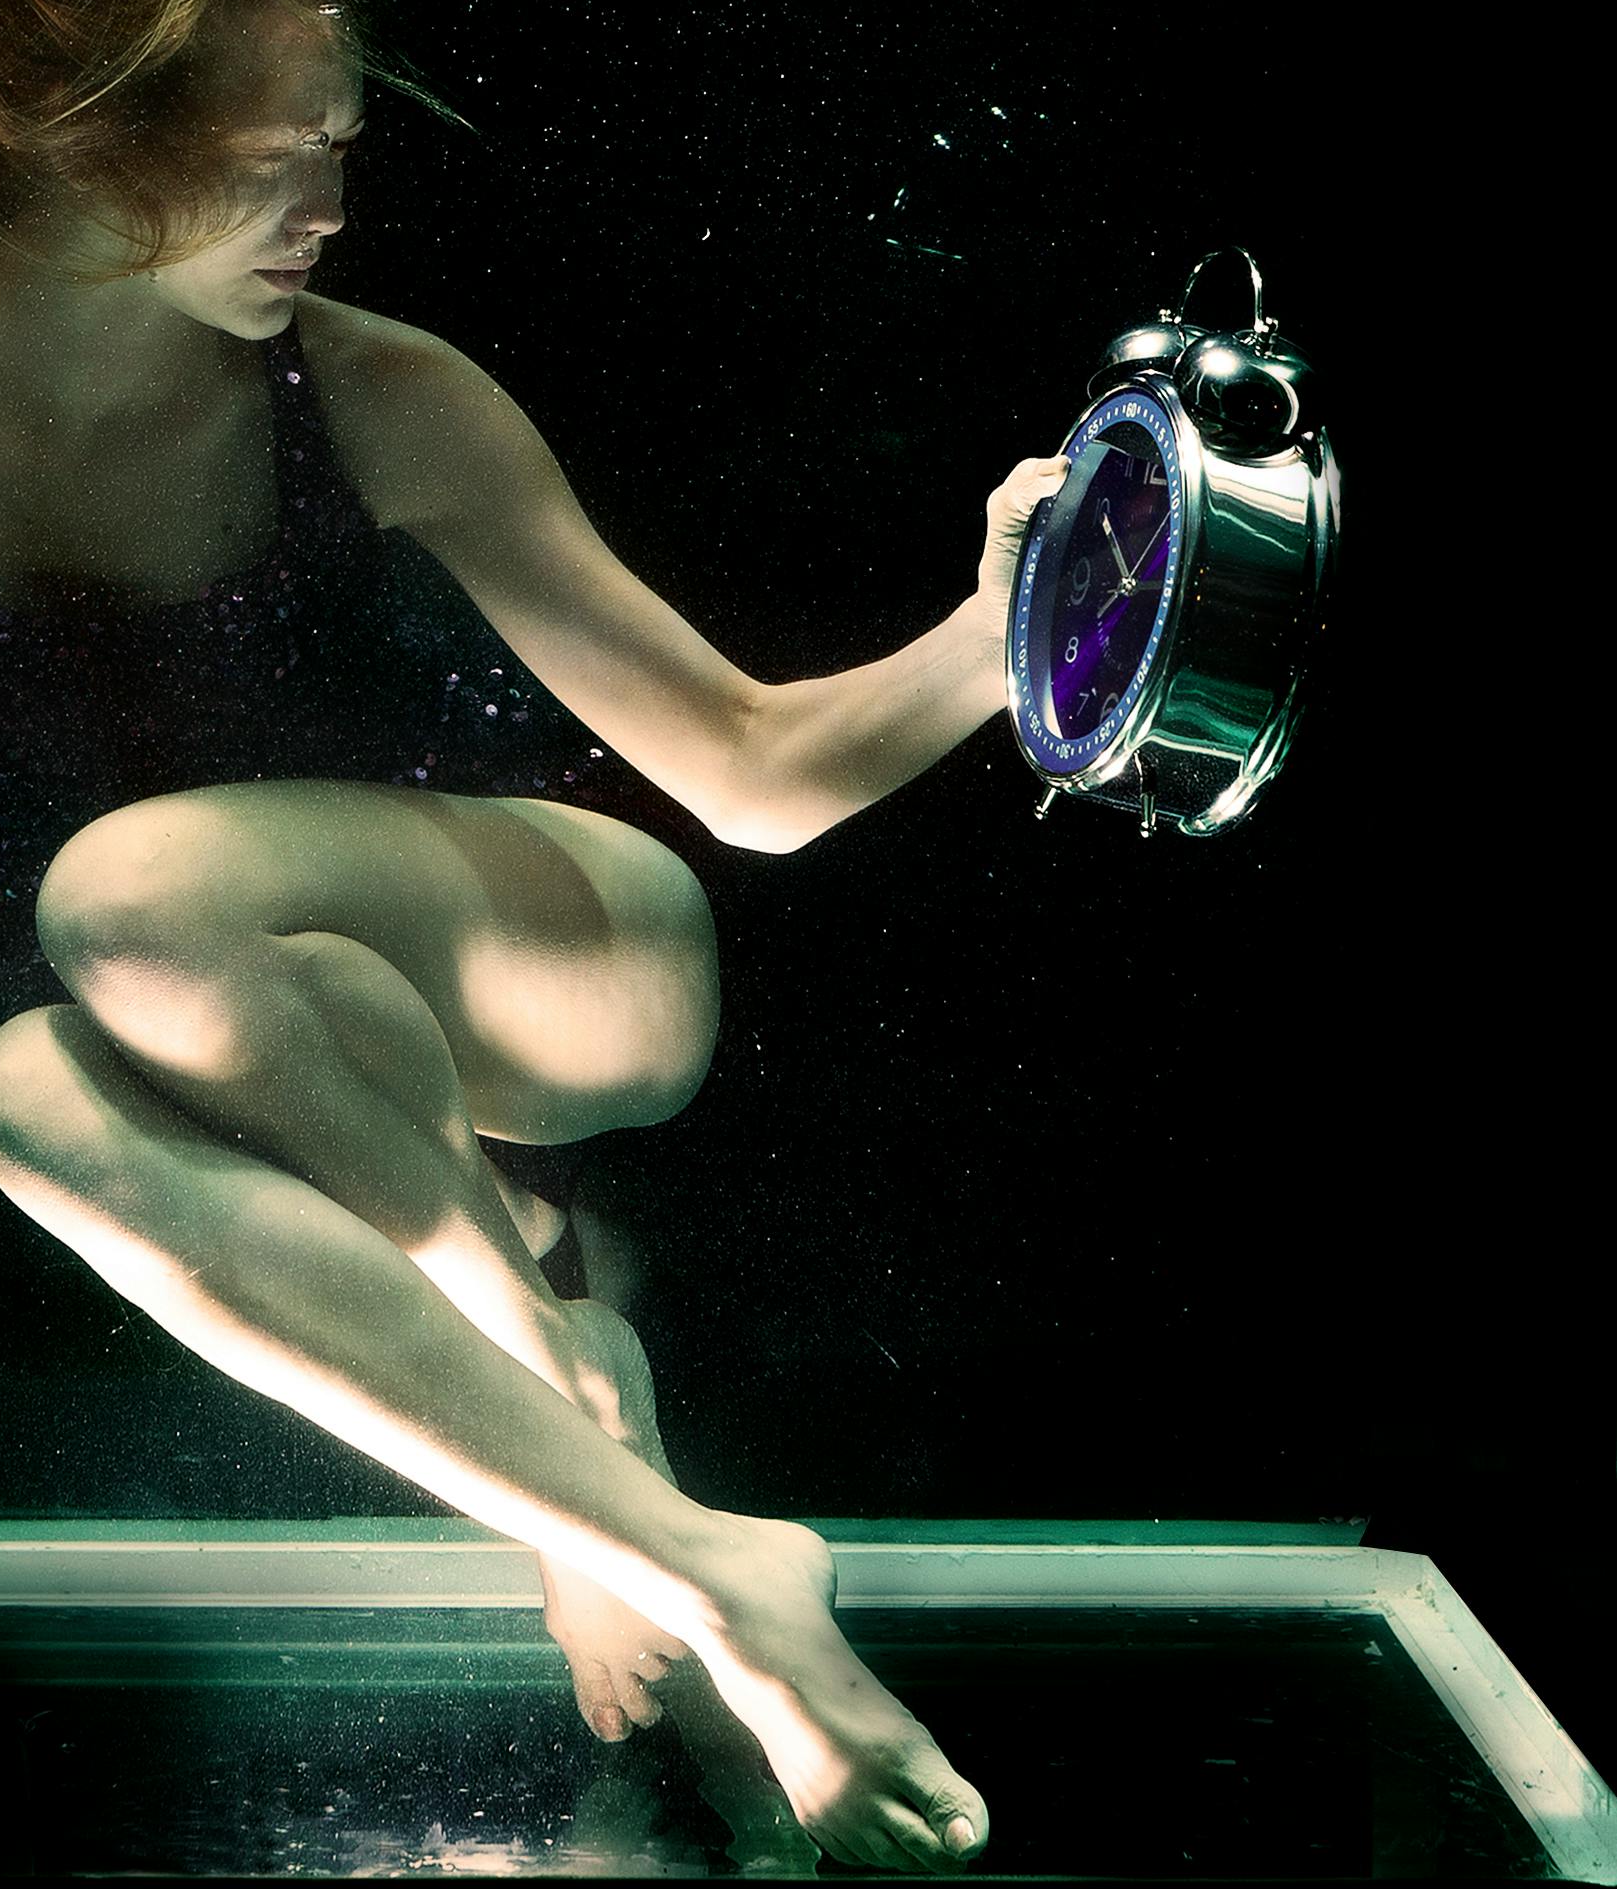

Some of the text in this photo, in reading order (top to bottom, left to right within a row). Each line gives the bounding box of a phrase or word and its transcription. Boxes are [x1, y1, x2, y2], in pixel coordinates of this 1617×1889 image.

[1126, 402, 1137, 418] 60
[1088, 419, 1099, 440] 55
[1157, 427, 1166, 442] 5
[1171, 489, 1181, 510] 10
[1069, 556, 1091, 605] 9
[1064, 636, 1079, 664] 8
[1079, 692, 1090, 717] 7
